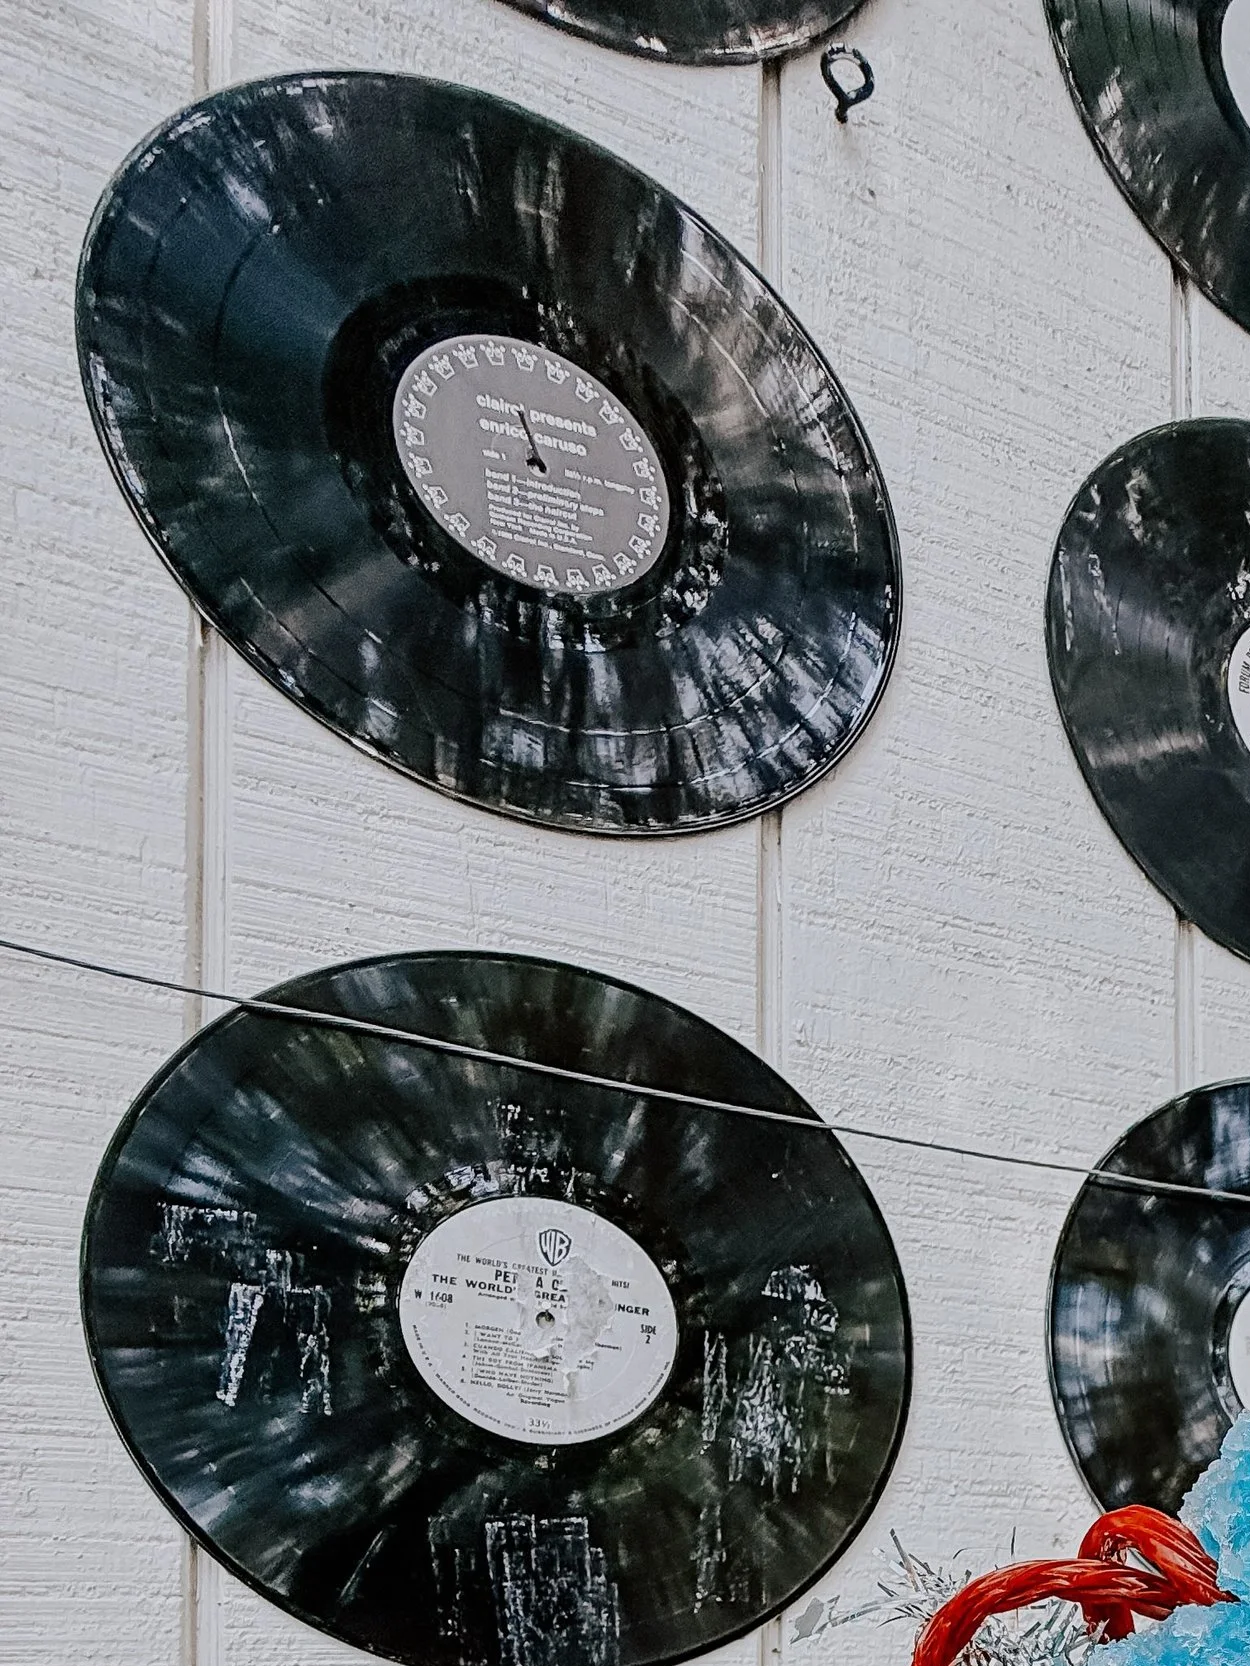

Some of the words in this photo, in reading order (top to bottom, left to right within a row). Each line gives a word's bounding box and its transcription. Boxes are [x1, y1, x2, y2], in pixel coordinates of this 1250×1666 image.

[529, 409, 597, 438] presents
[533, 432, 587, 457] caruso
[456, 1253, 471, 1263] THE
[475, 1256, 508, 1269] WORLD'S
[432, 1273, 458, 1286] THE
[414, 1288, 423, 1300] W
[640, 1324, 657, 1336] SIDE
[645, 1335, 651, 1344] 2
